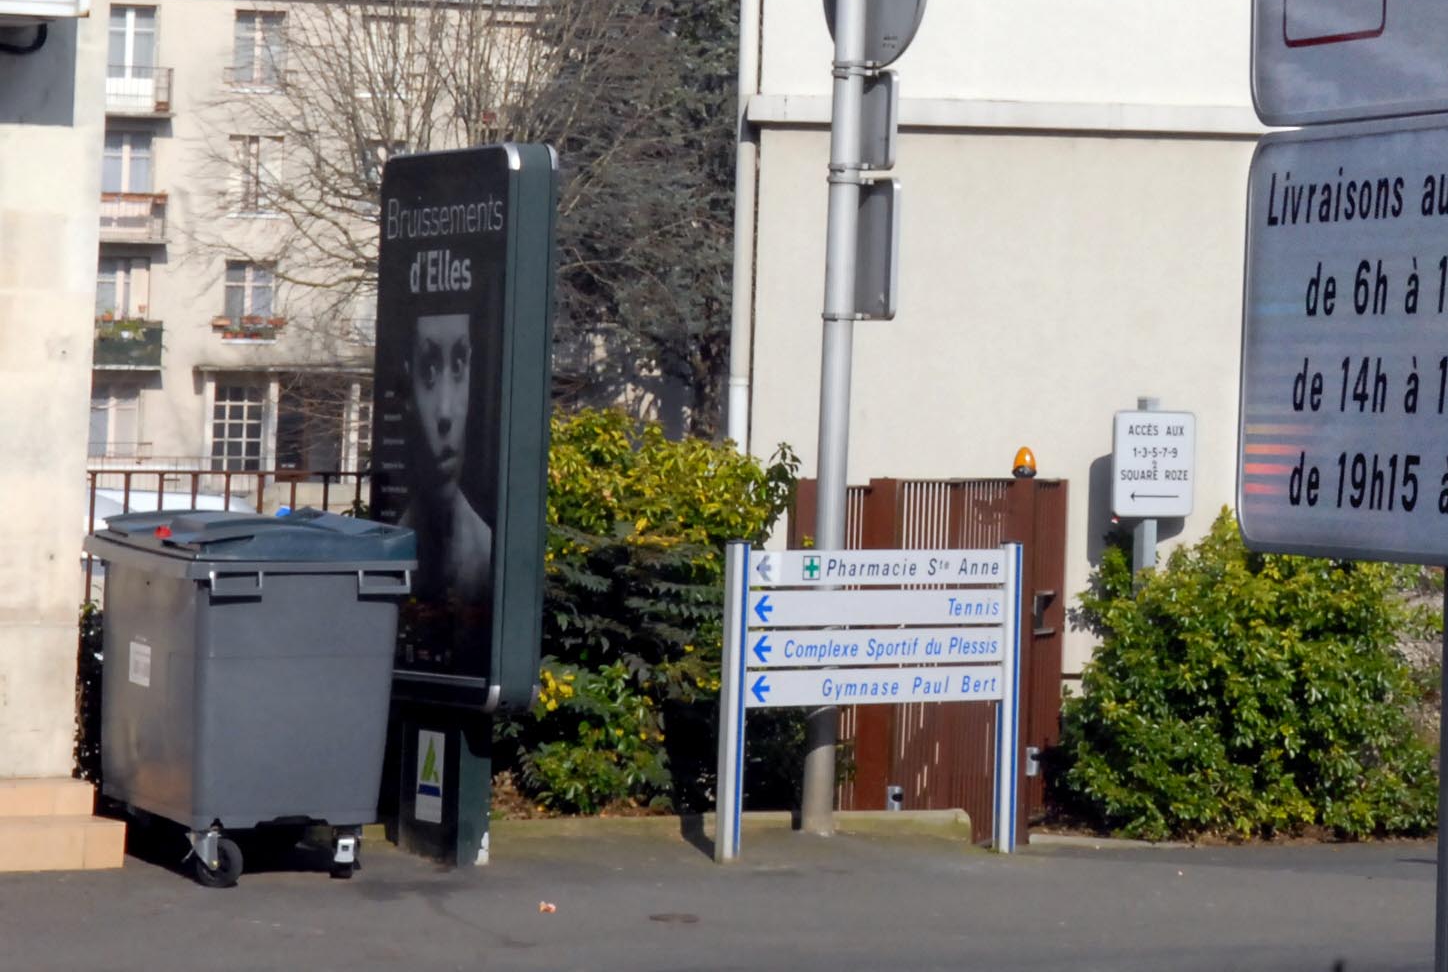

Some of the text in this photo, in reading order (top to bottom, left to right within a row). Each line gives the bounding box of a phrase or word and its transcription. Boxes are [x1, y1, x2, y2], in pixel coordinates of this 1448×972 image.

[1267, 167, 1405, 227] Livraisons
[386, 194, 504, 240] Bruissements
[410, 249, 472, 293] d'Elles
[1305, 262, 1337, 316] de
[1353, 259, 1388, 315] 6h
[1404, 257, 1420, 314] à
[1292, 357, 1323, 412] de
[1339, 356, 1388, 413] 14h
[1404, 356, 1419, 414] à
[1166, 426, 1184, 436] AUX
[1133, 447, 1178, 458] 1-3-5-7-9
[1120, 469, 1188, 481] SQUARE ROZE
[1289, 451, 1320, 507] de
[1337, 452, 1422, 512] 19h15
[826, 558, 917, 577] Pharmacie
[958, 558, 999, 576] Anne
[948, 598, 999, 616] Tennis
[784, 636, 998, 662] Complexe Sportif du Plessis
[822, 675, 997, 700] Gymnase Paul Bert
